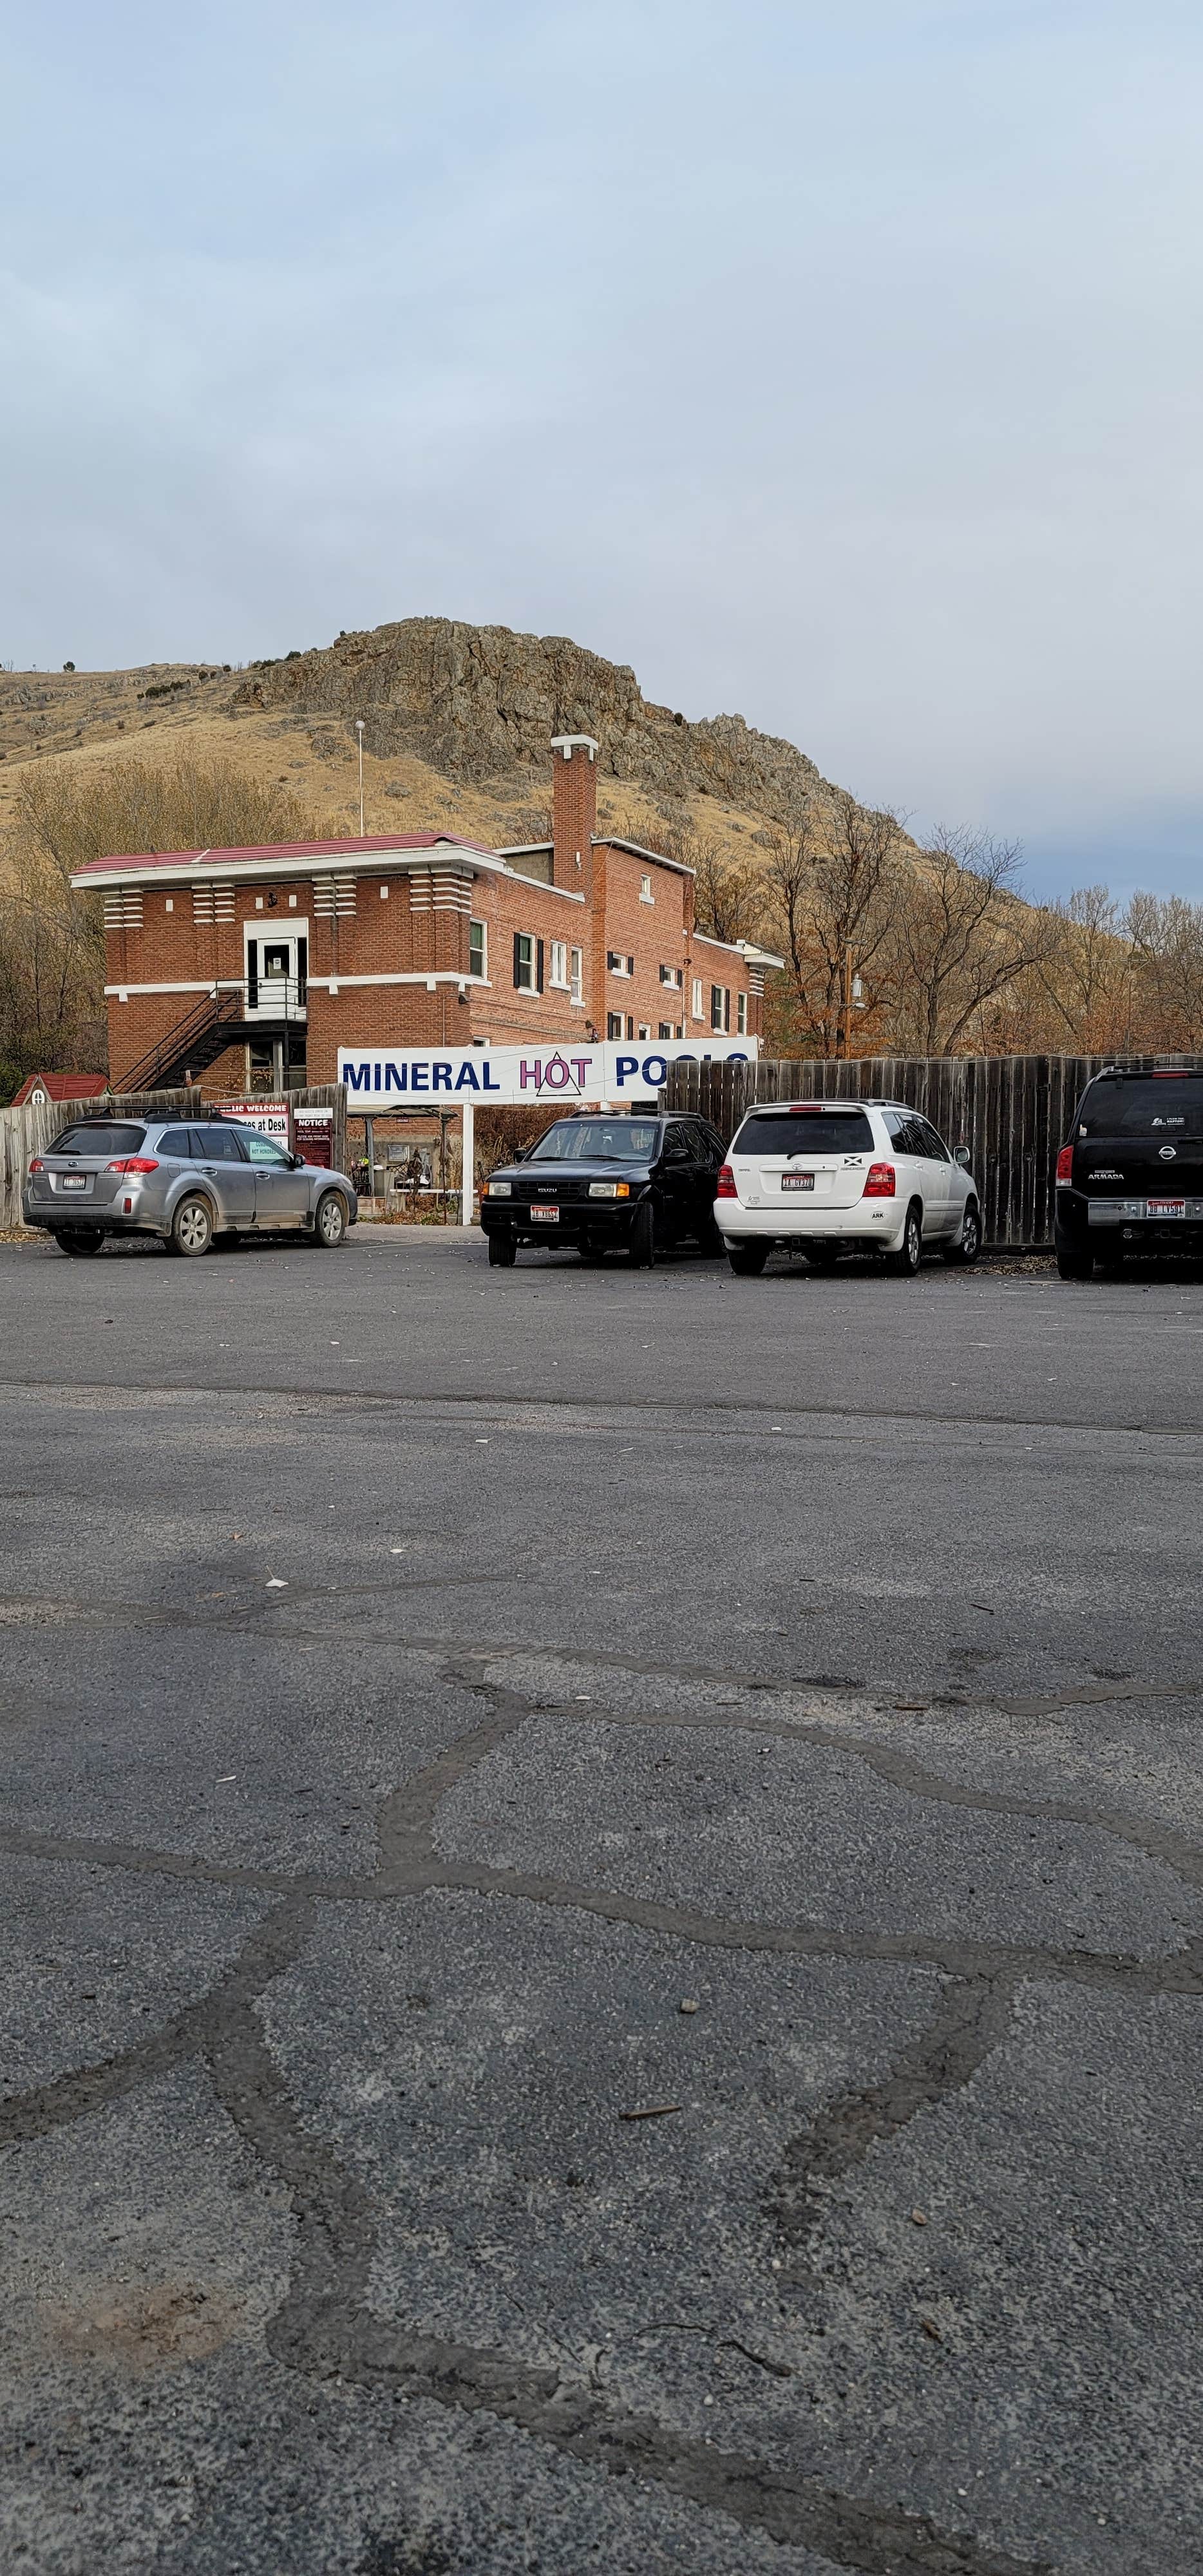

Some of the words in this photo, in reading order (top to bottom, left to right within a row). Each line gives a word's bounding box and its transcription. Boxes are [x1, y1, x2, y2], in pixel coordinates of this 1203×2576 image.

[343, 1062, 500, 1091] MINERAL
[520, 1059, 592, 1088] HOT
[258, 1119, 266, 1131] at
[268, 1119, 286, 1131] Desk
